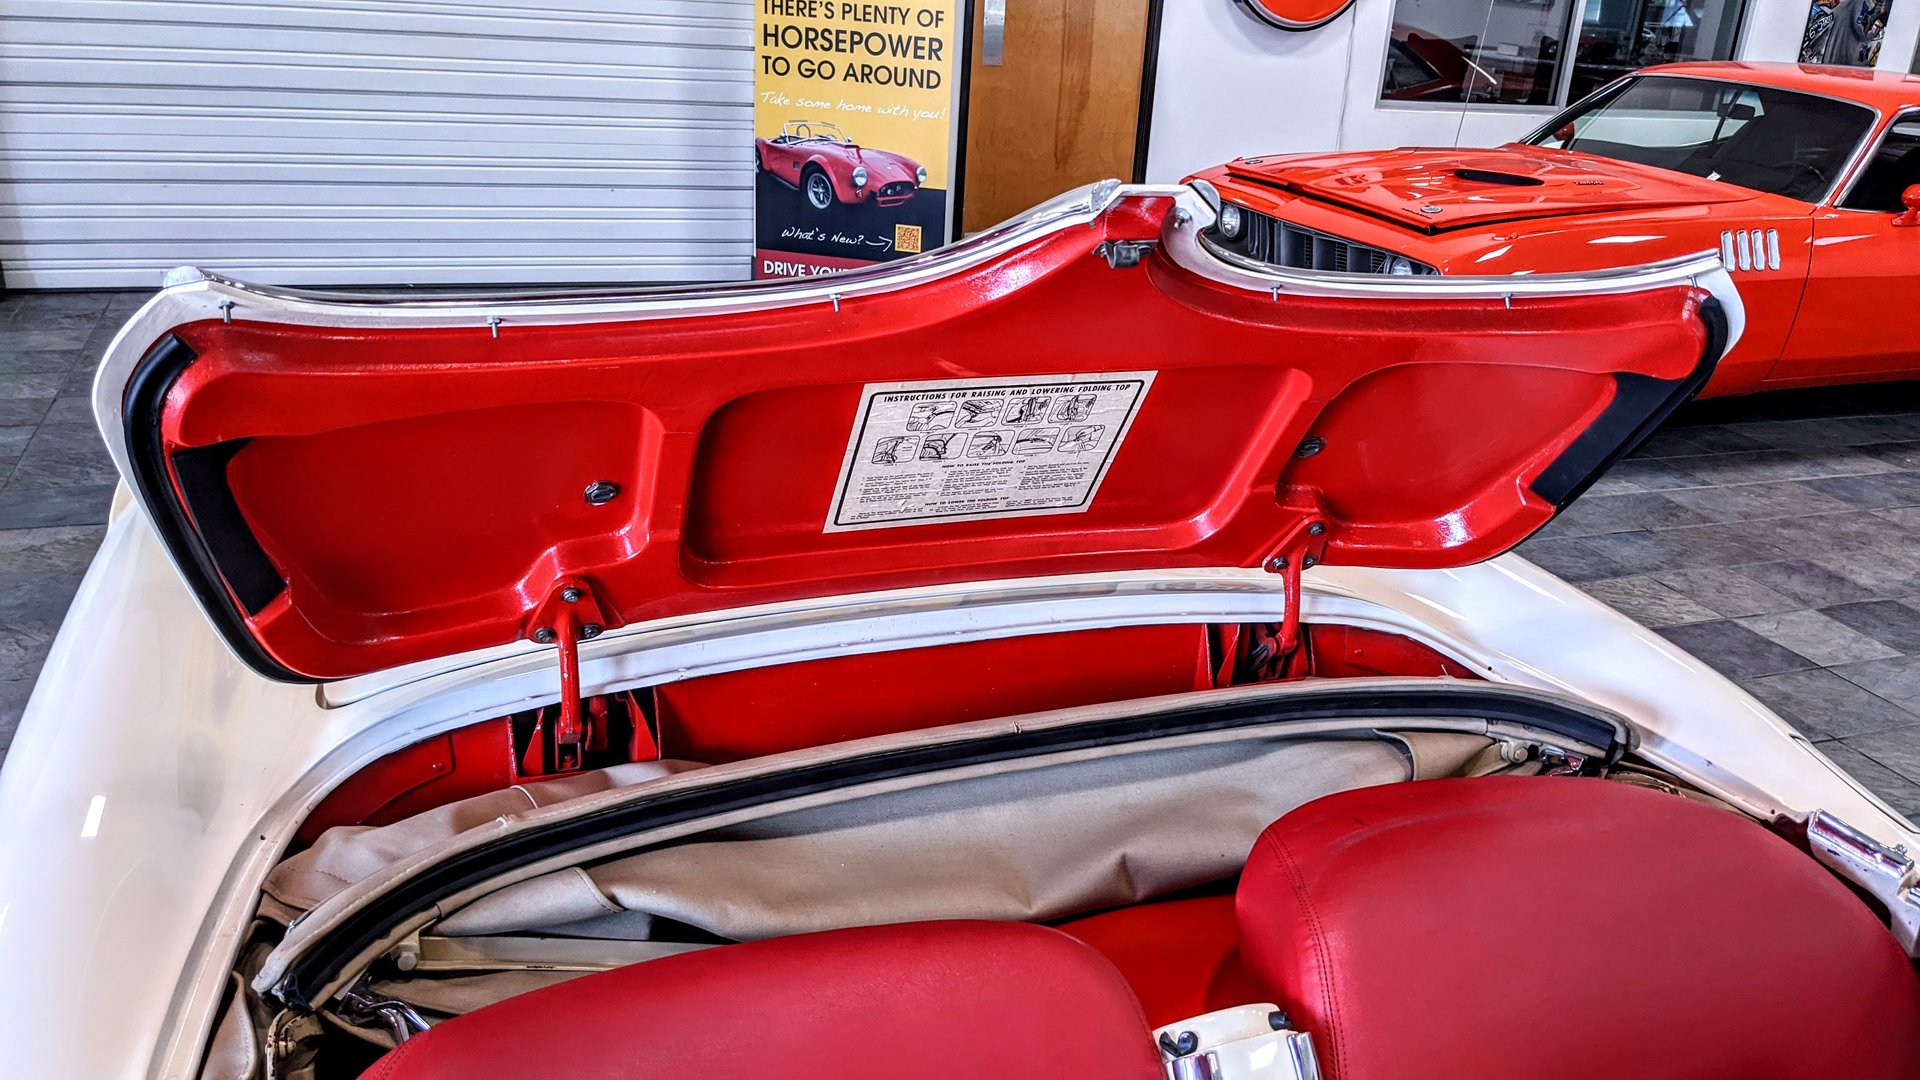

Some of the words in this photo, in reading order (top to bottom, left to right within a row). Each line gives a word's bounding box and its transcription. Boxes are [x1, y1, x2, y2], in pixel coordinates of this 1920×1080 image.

[763, 0, 834, 19] THERE'S
[842, 3, 911, 25] PLENTY
[917, 9, 945, 28] OF
[763, 24, 943, 61] HORSEPOWER
[762, 55, 790, 76] TO
[797, 59, 836, 80] GO
[842, 62, 942, 90] AROUND
[761, 92, 790, 107] Take
[795, 97, 831, 109] some
[836, 99, 872, 113] home
[877, 104, 909, 117] with
[912, 107, 946, 121] you!
[781, 226, 826, 241] What's
[831, 232, 864, 245] New?
[764, 260, 805, 277] DRIVE
[884, 392, 946, 402] INSTRUCTIONS
[951, 391, 967, 399] FOR
[971, 390, 1006, 398] RAISING
[1031, 386, 1073, 395] LOWERING
